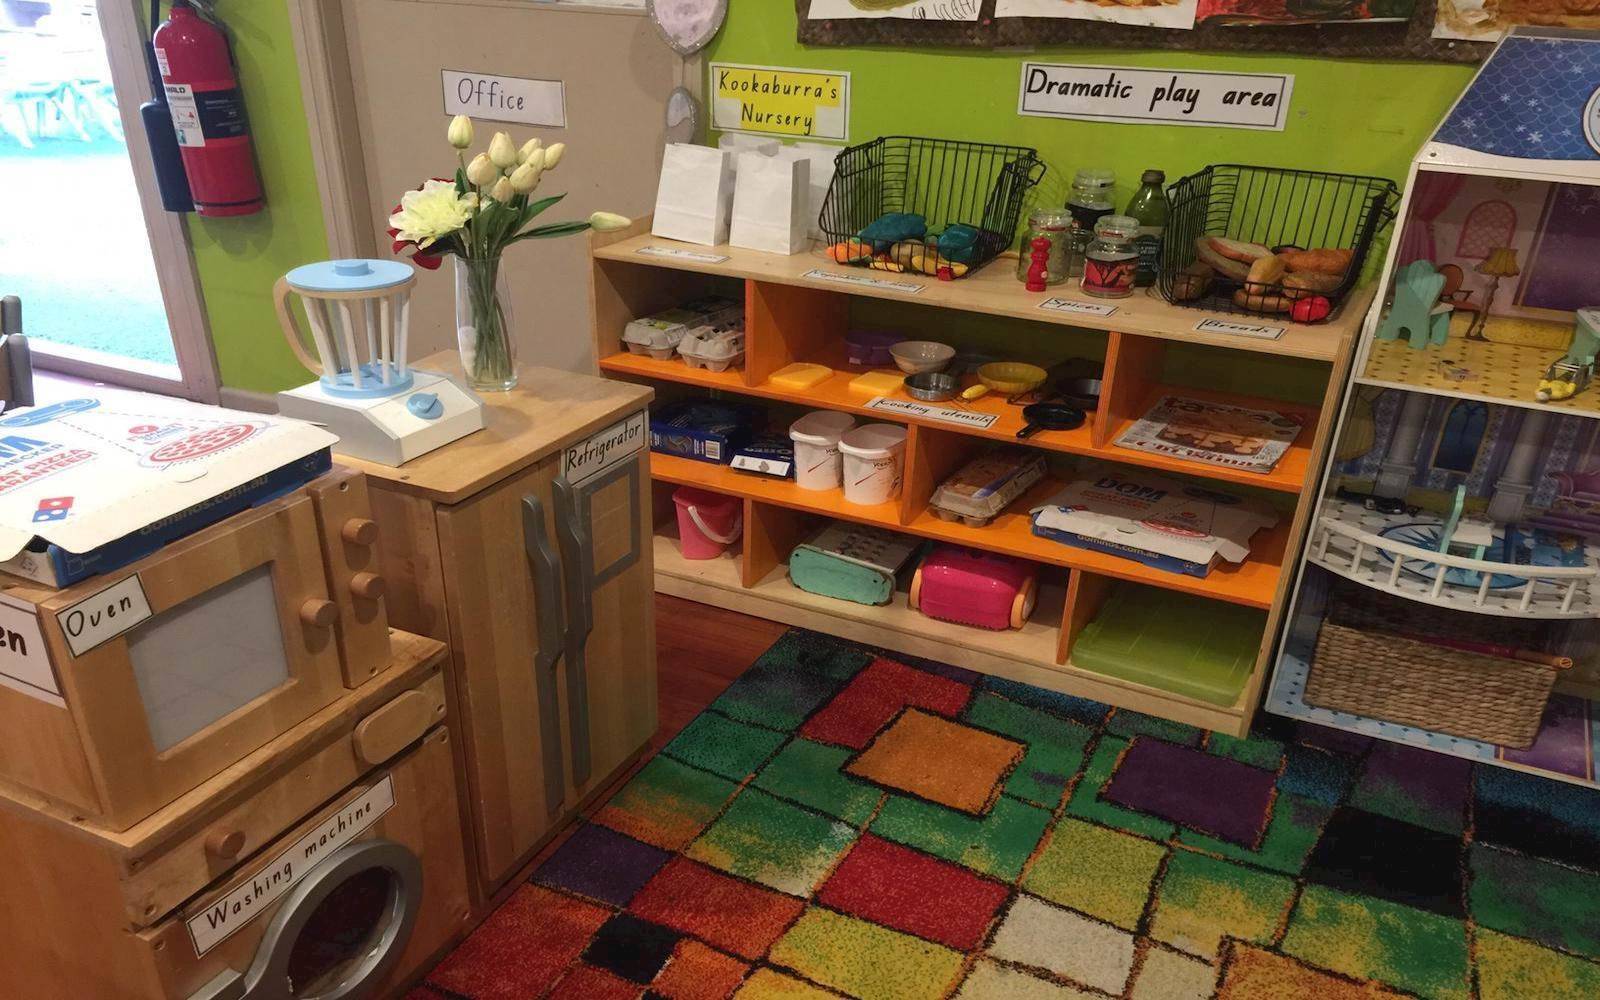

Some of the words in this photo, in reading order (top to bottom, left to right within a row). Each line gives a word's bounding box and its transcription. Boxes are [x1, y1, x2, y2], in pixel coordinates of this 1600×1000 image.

[457, 77, 524, 110] Office
[719, 71, 837, 99] Kookaburra's
[1026, 68, 1133, 99] Dramatic
[1148, 75, 1200, 114] play
[1222, 90, 1277, 107] area
[741, 102, 812, 136] Nursery
[1205, 320, 1269, 333] Breads
[879, 399, 930, 415] Cooking
[941, 408, 989, 423] utensils
[567, 421, 641, 472] Refrigerator
[66, 597, 132, 637] Oven
[206, 861, 293, 930] Washing
[304, 801, 371, 859] machine
